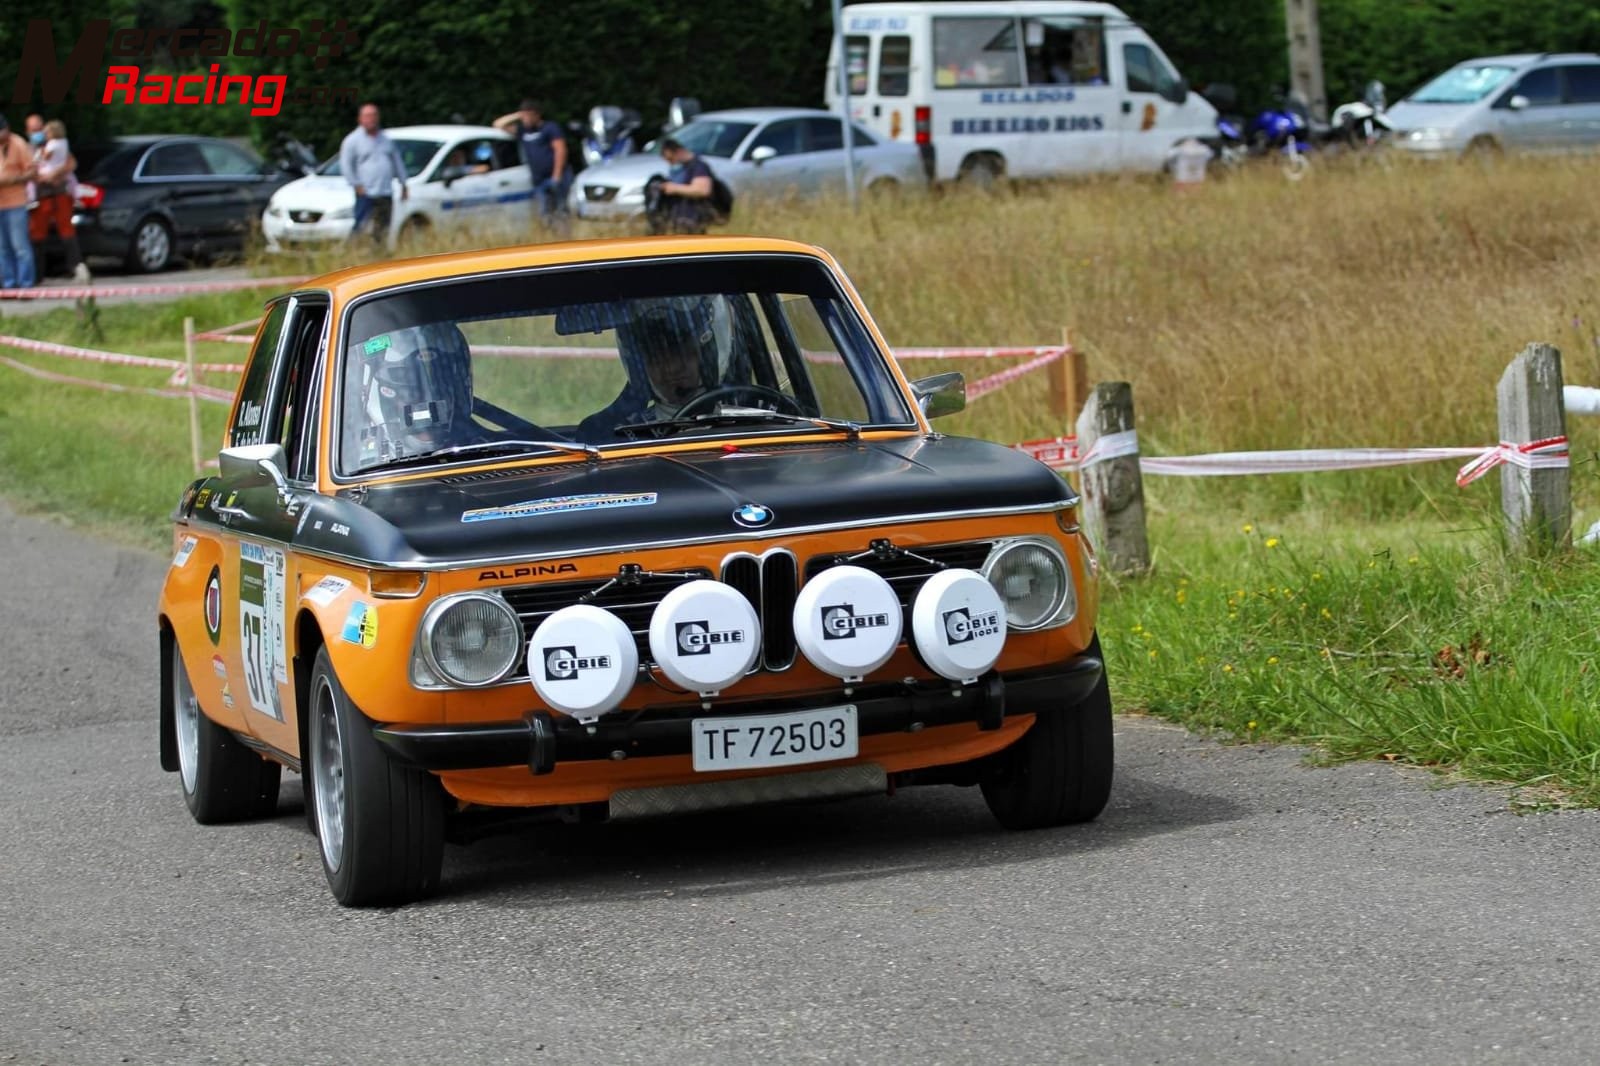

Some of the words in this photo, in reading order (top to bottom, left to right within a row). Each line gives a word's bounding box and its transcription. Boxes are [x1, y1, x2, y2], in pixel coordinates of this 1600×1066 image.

[981, 90, 1076, 103] HELADOS
[478, 563, 578, 581] ALPINA
[955, 615, 997, 632] CIBIE
[243, 611, 267, 705] 37
[703, 728, 740, 760] TF
[748, 718, 846, 758] 72503
